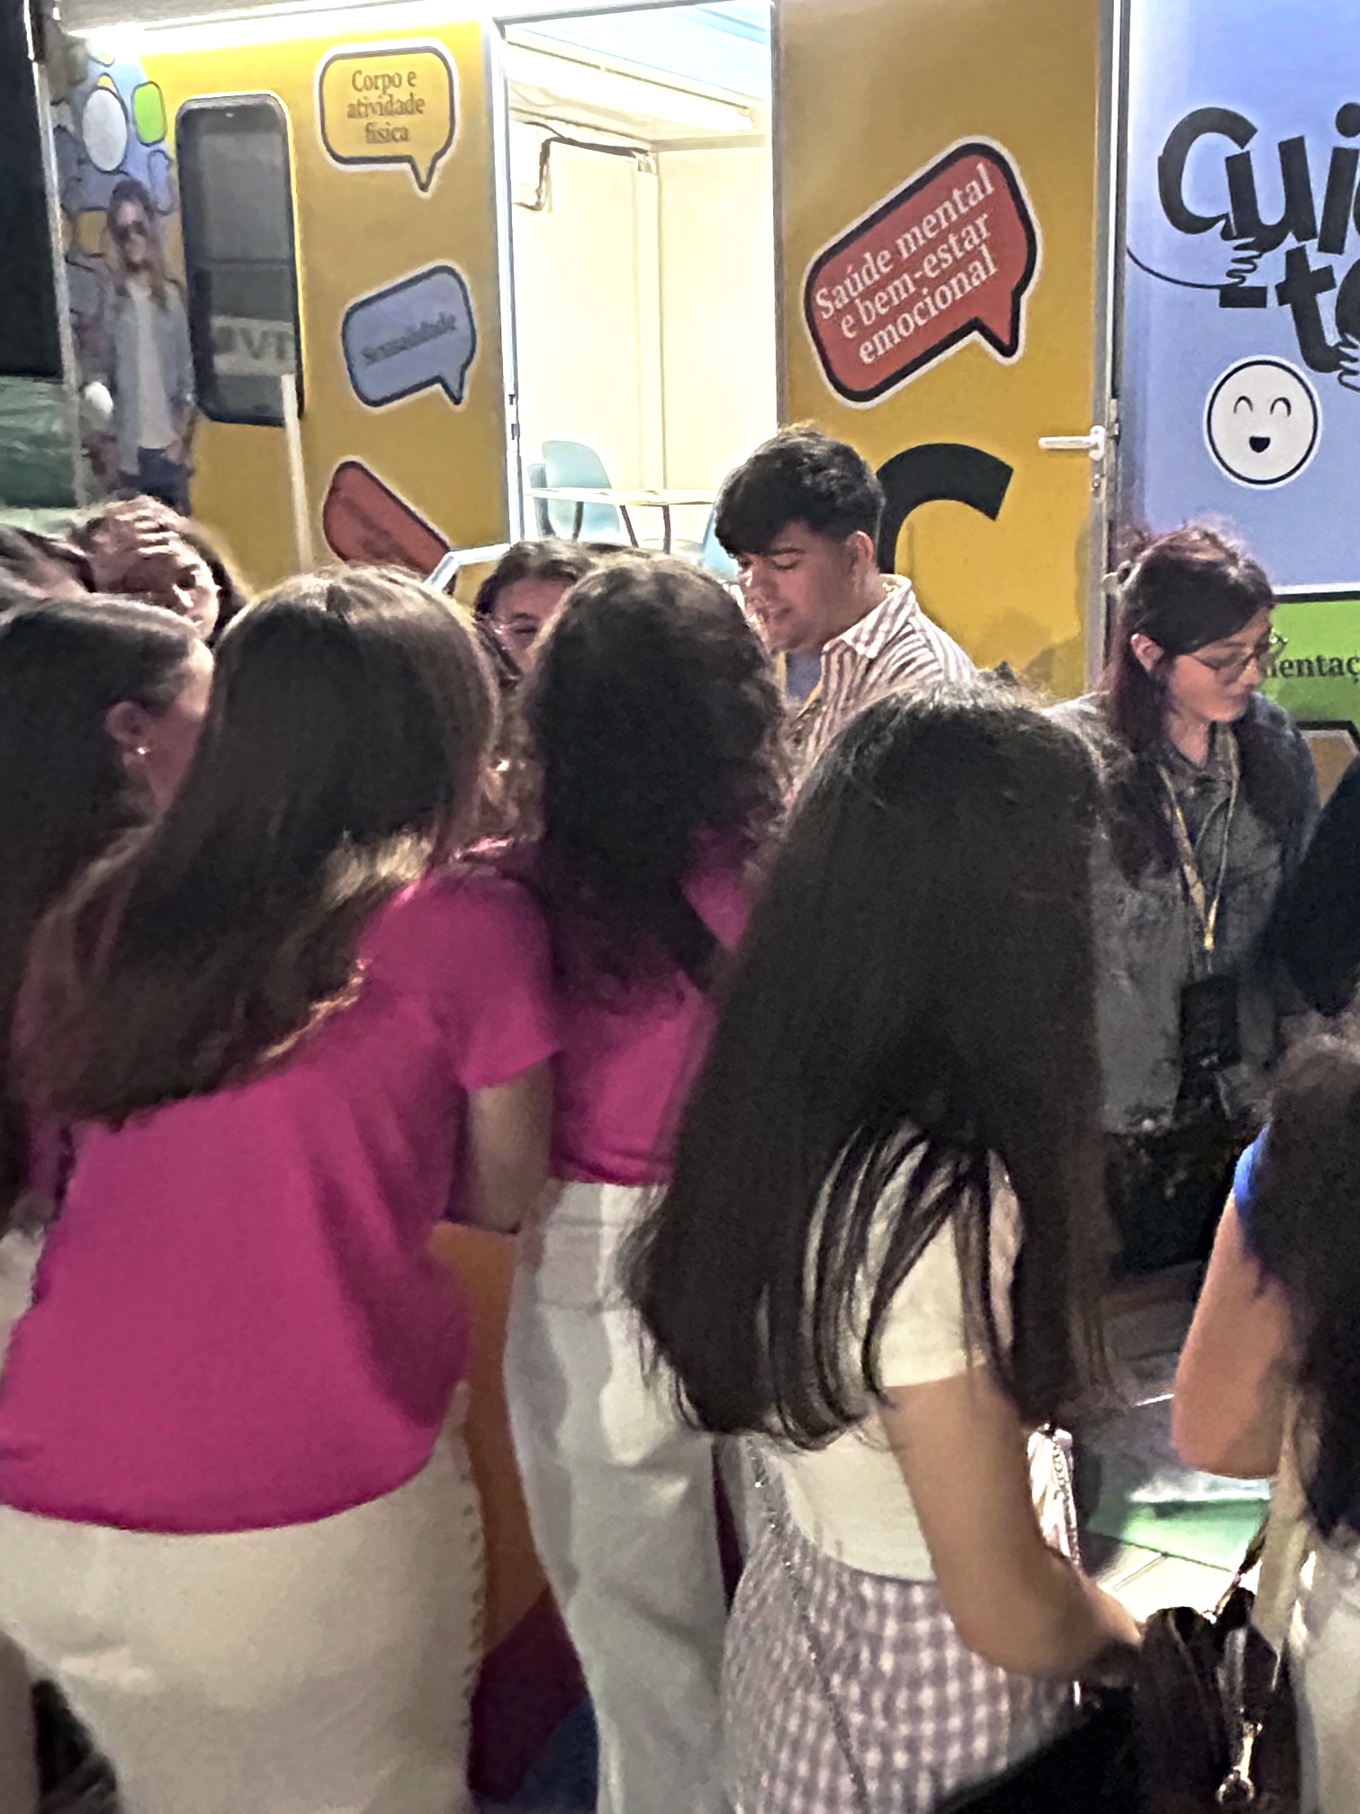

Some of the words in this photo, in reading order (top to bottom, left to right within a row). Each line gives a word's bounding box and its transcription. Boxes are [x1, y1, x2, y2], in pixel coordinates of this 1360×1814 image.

[347, 91, 426, 119] atividade
[351, 69, 403, 95] Corpo
[407, 70, 418, 88] e
[815, 251, 894, 320] Saúde
[895, 161, 994, 260] mental
[840, 313, 858, 339] e
[855, 212, 992, 327] bem-estar
[858, 242, 998, 365] emocional
